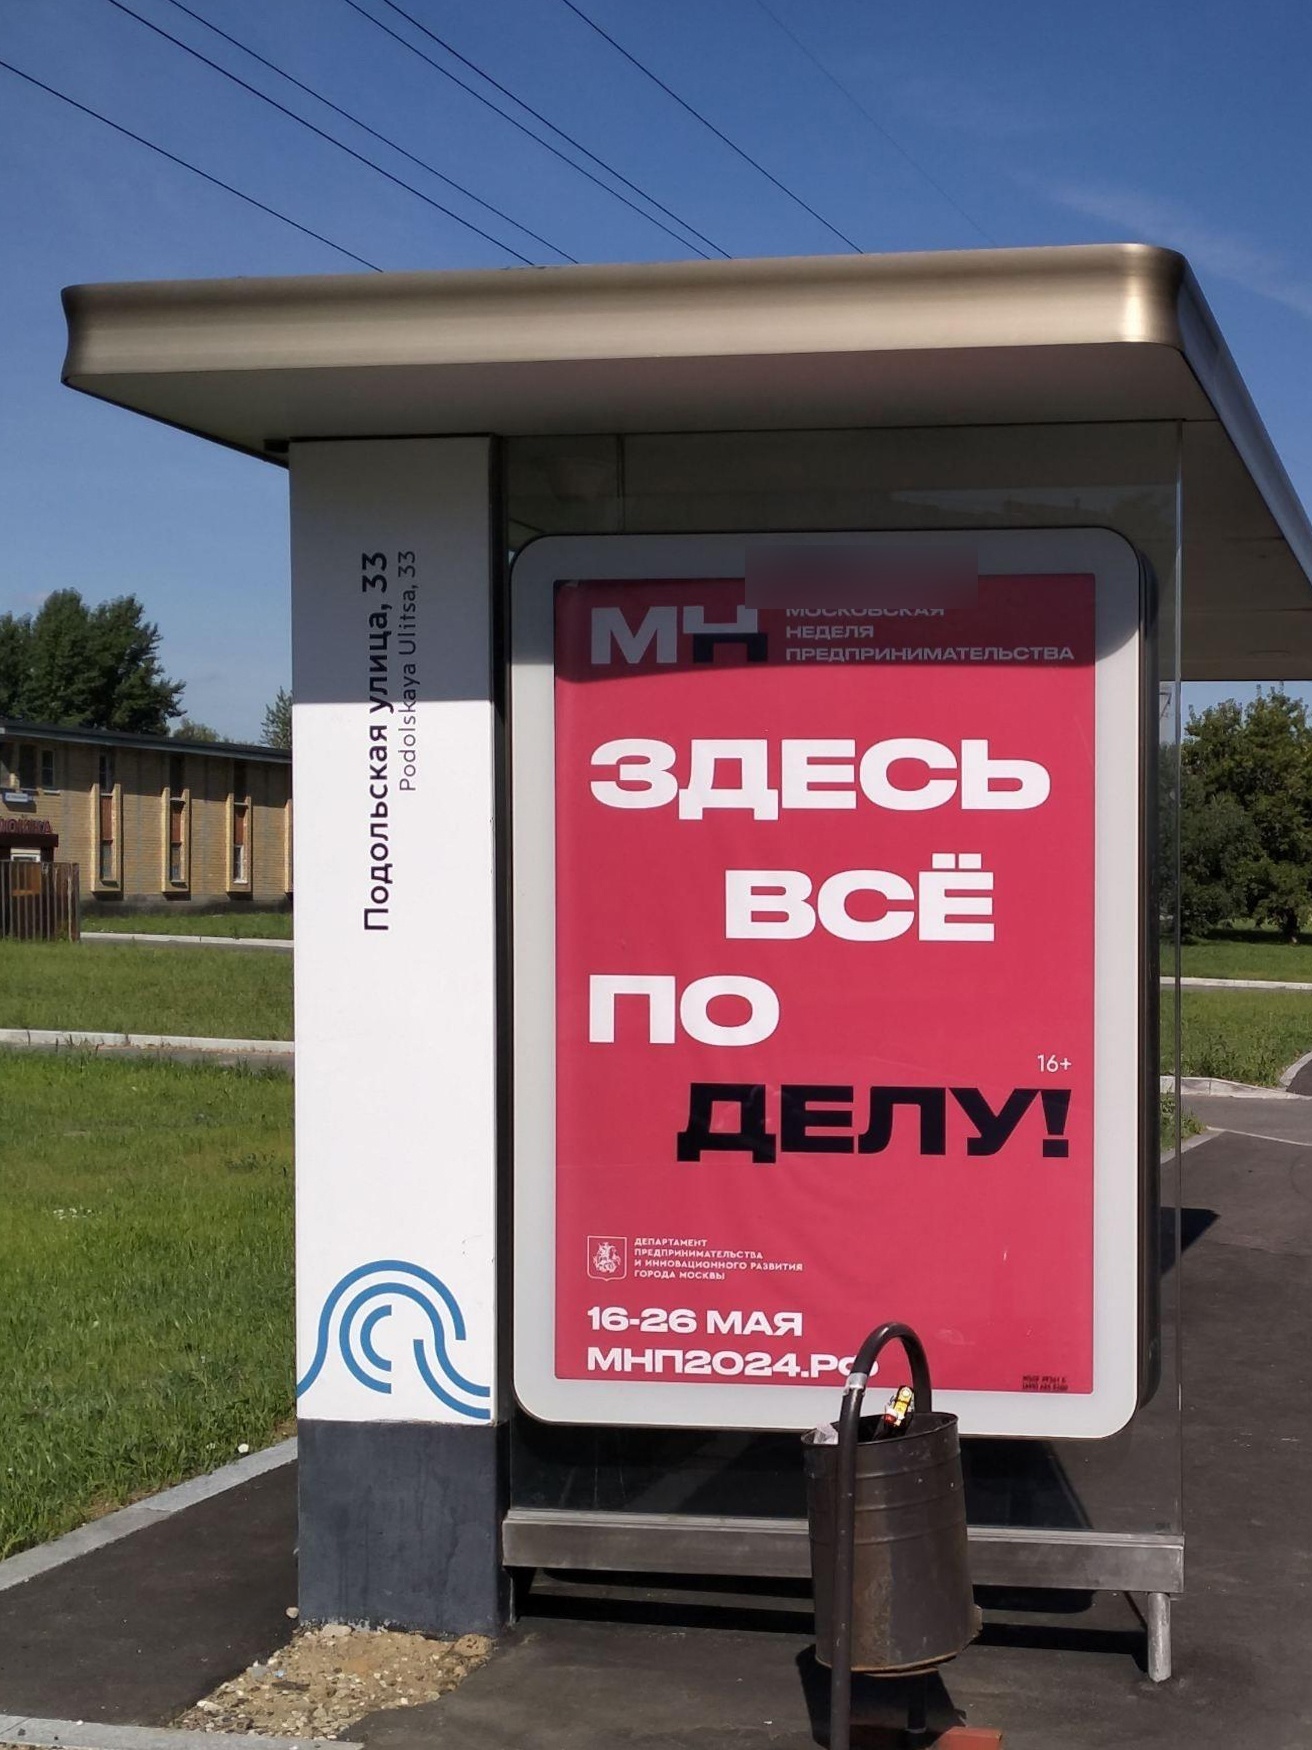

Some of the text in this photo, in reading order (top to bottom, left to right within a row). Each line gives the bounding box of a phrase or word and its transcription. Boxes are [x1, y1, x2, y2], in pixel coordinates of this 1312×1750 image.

[785, 625, 875, 640] НЕДЕЛЯ
[785, 646, 1075, 663] ПРЕДПРИНИМАТЕЛЬСТВА
[397, 550, 421, 792] Podolskaya Ulitsa, 33
[361, 551, 395, 931] Подольская улица, 33
[589, 737, 1052, 822] ЗДЕСЬ
[724, 852, 996, 943] ВСЁ
[588, 974, 781, 1048] ПО
[1037, 1054, 1072, 1073] 16+
[676, 1082, 1072, 1164] ДЕЛУ!
[634, 1237, 708, 1248] ДЕПАРТАМЕНТ
[634, 1248, 764, 1260] ПРЕДПРИНИМАТЕЛЬСТВА
[634, 1259, 804, 1272] И ИННОВАЦИОННОГО РАЗВИТИЯ
[634, 1270, 726, 1281] ГОРОДА МОСКВЫ
[587, 1306, 803, 1337] 16-26 МАЯ
